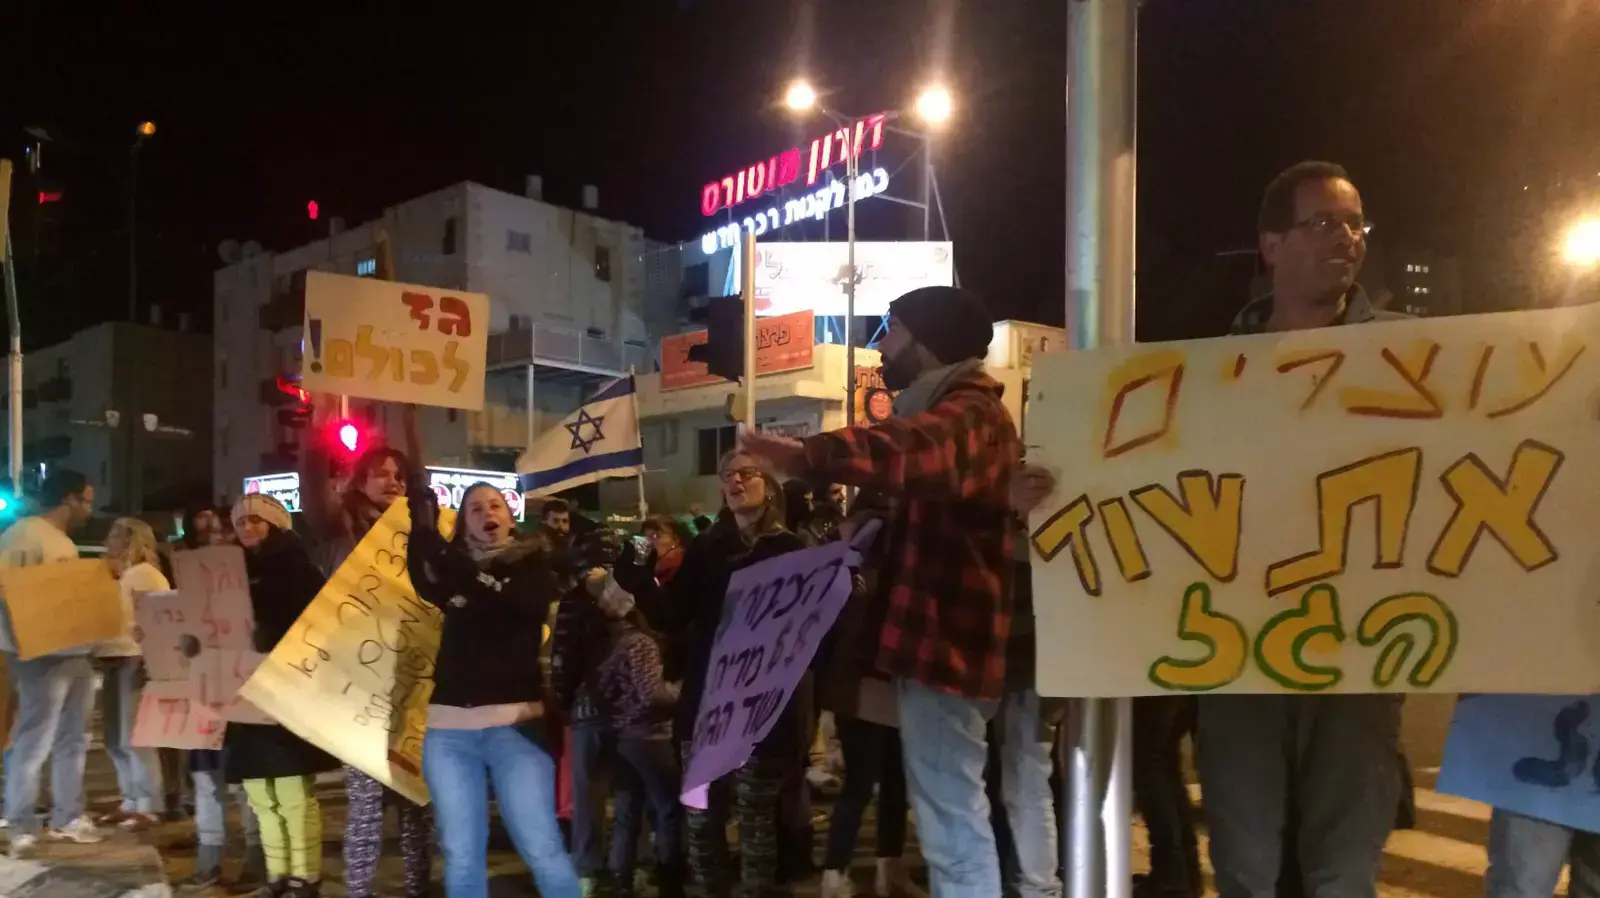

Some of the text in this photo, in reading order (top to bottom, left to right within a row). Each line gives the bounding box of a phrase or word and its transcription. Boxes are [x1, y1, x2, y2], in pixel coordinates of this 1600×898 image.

[702, 113, 885, 216] דורון מוטורס
[849, 167, 890, 202] כמ
[784, 179, 846, 225] לקנות
[702, 221, 741, 255] חדש
[401, 290, 472, 337] גז
[308, 318, 471, 394] לכולם!
[1102, 341, 1587, 458] עוצרים
[1030, 439, 1565, 597] את שוד
